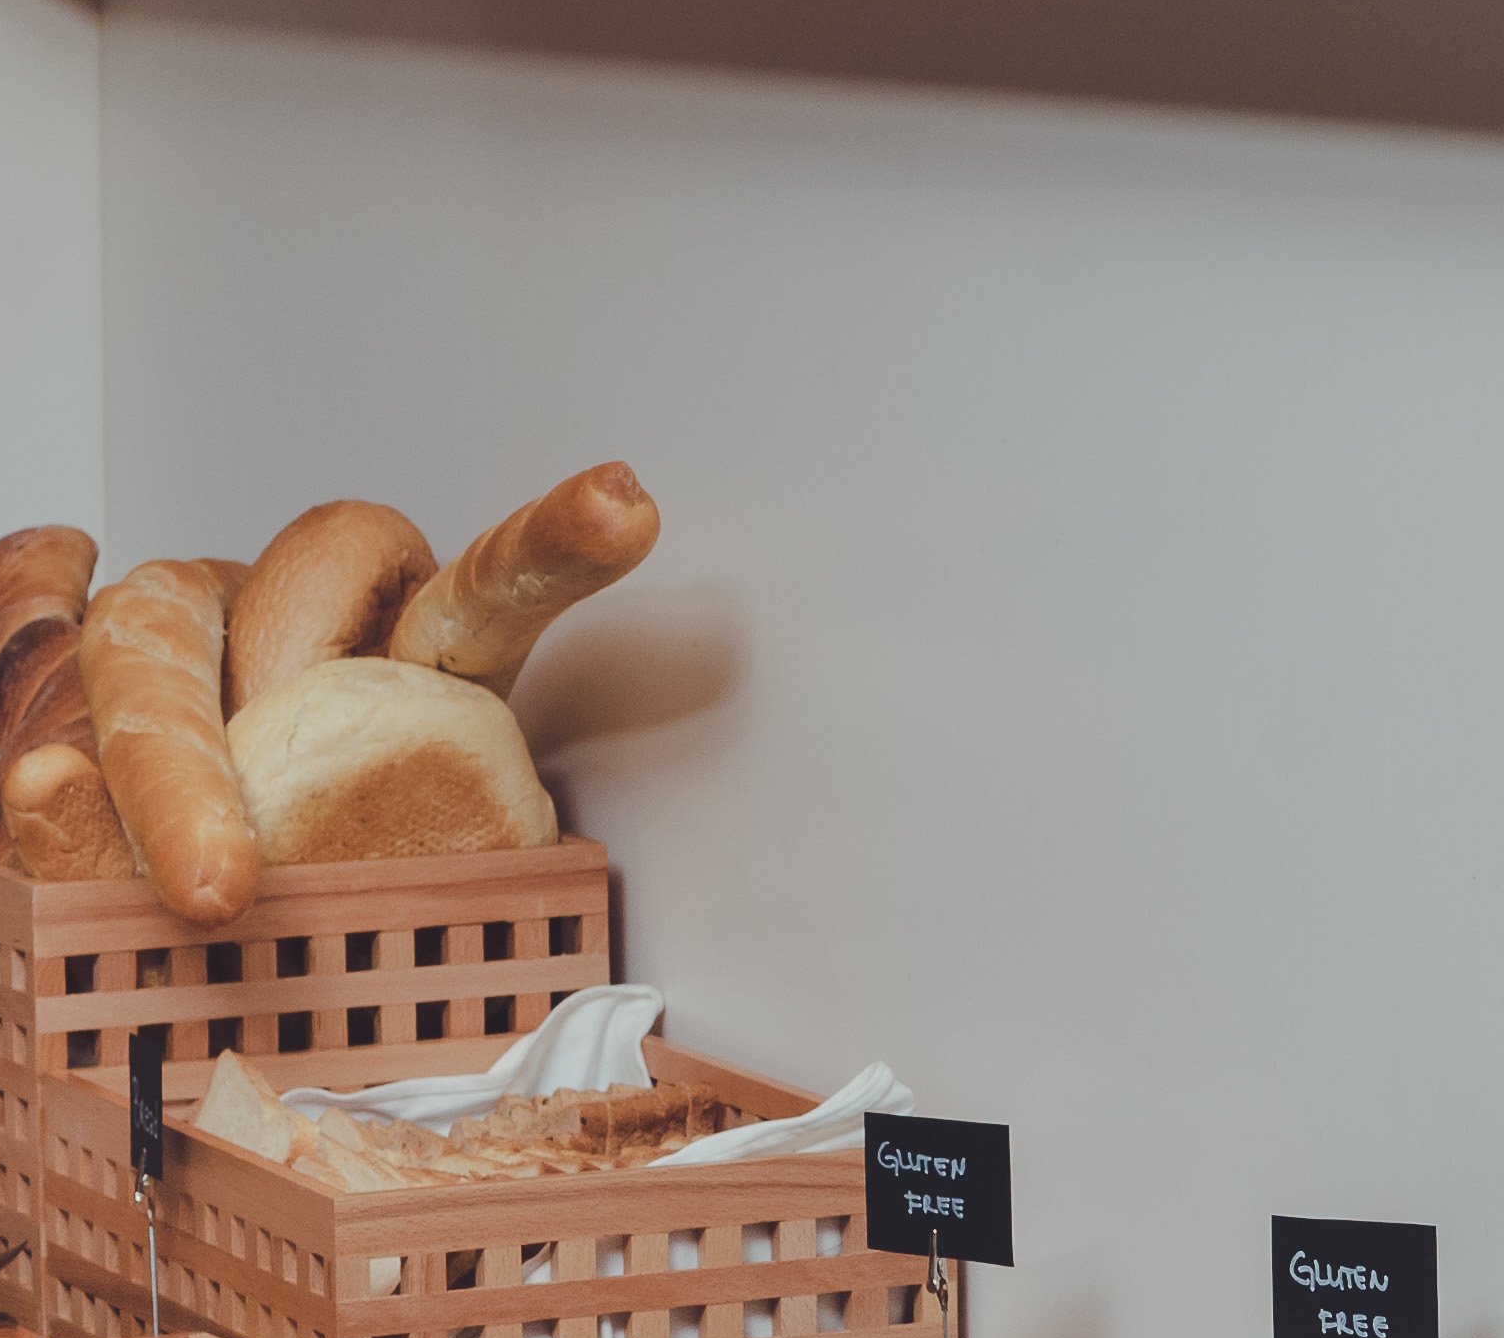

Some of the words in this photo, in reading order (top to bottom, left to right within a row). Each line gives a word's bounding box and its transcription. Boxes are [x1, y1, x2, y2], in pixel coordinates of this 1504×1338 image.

[878, 1141, 965, 1180] GLUTEN
[904, 1190, 964, 1218] FREE
[1290, 1251, 1388, 1292] GLUTEN
[1318, 1309, 1389, 1338] FREE
